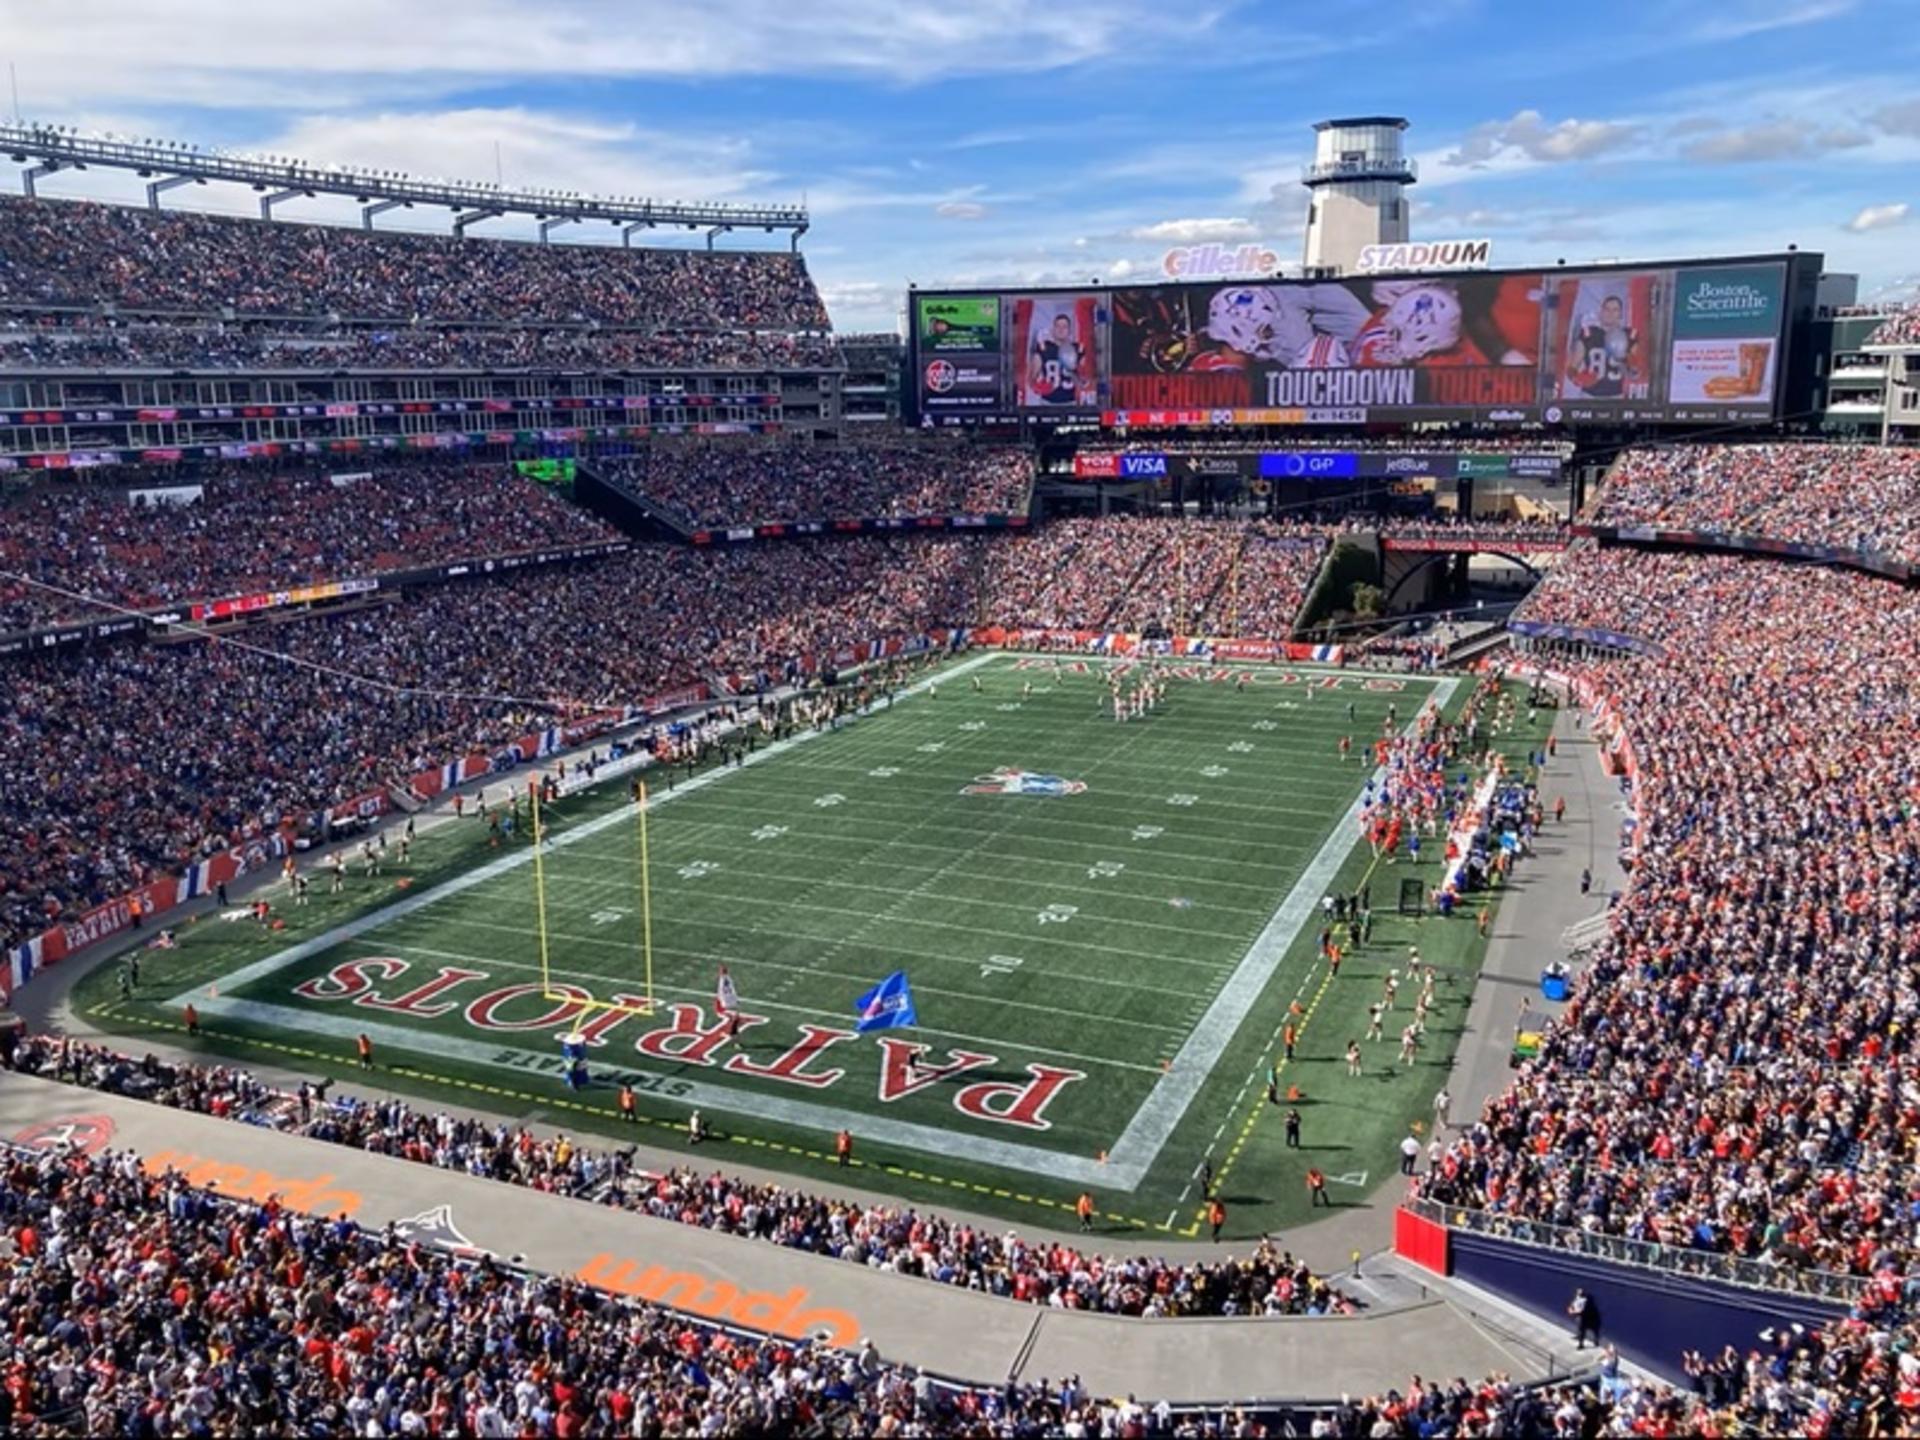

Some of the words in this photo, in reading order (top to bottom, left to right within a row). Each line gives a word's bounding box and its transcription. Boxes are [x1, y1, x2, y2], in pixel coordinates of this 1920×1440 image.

[1164, 244, 1278, 277] Gillette
[1357, 240, 1489, 269] STADIUM
[1698, 282, 1750, 298] Boston
[1687, 293, 1768, 312] Scientific
[1266, 371, 1413, 406] TOUCHDOWN
[1125, 458, 1167, 474] VISA
[1385, 458, 1429, 473] jetBlue
[297, 957, 1086, 1130] PATRIOTS
